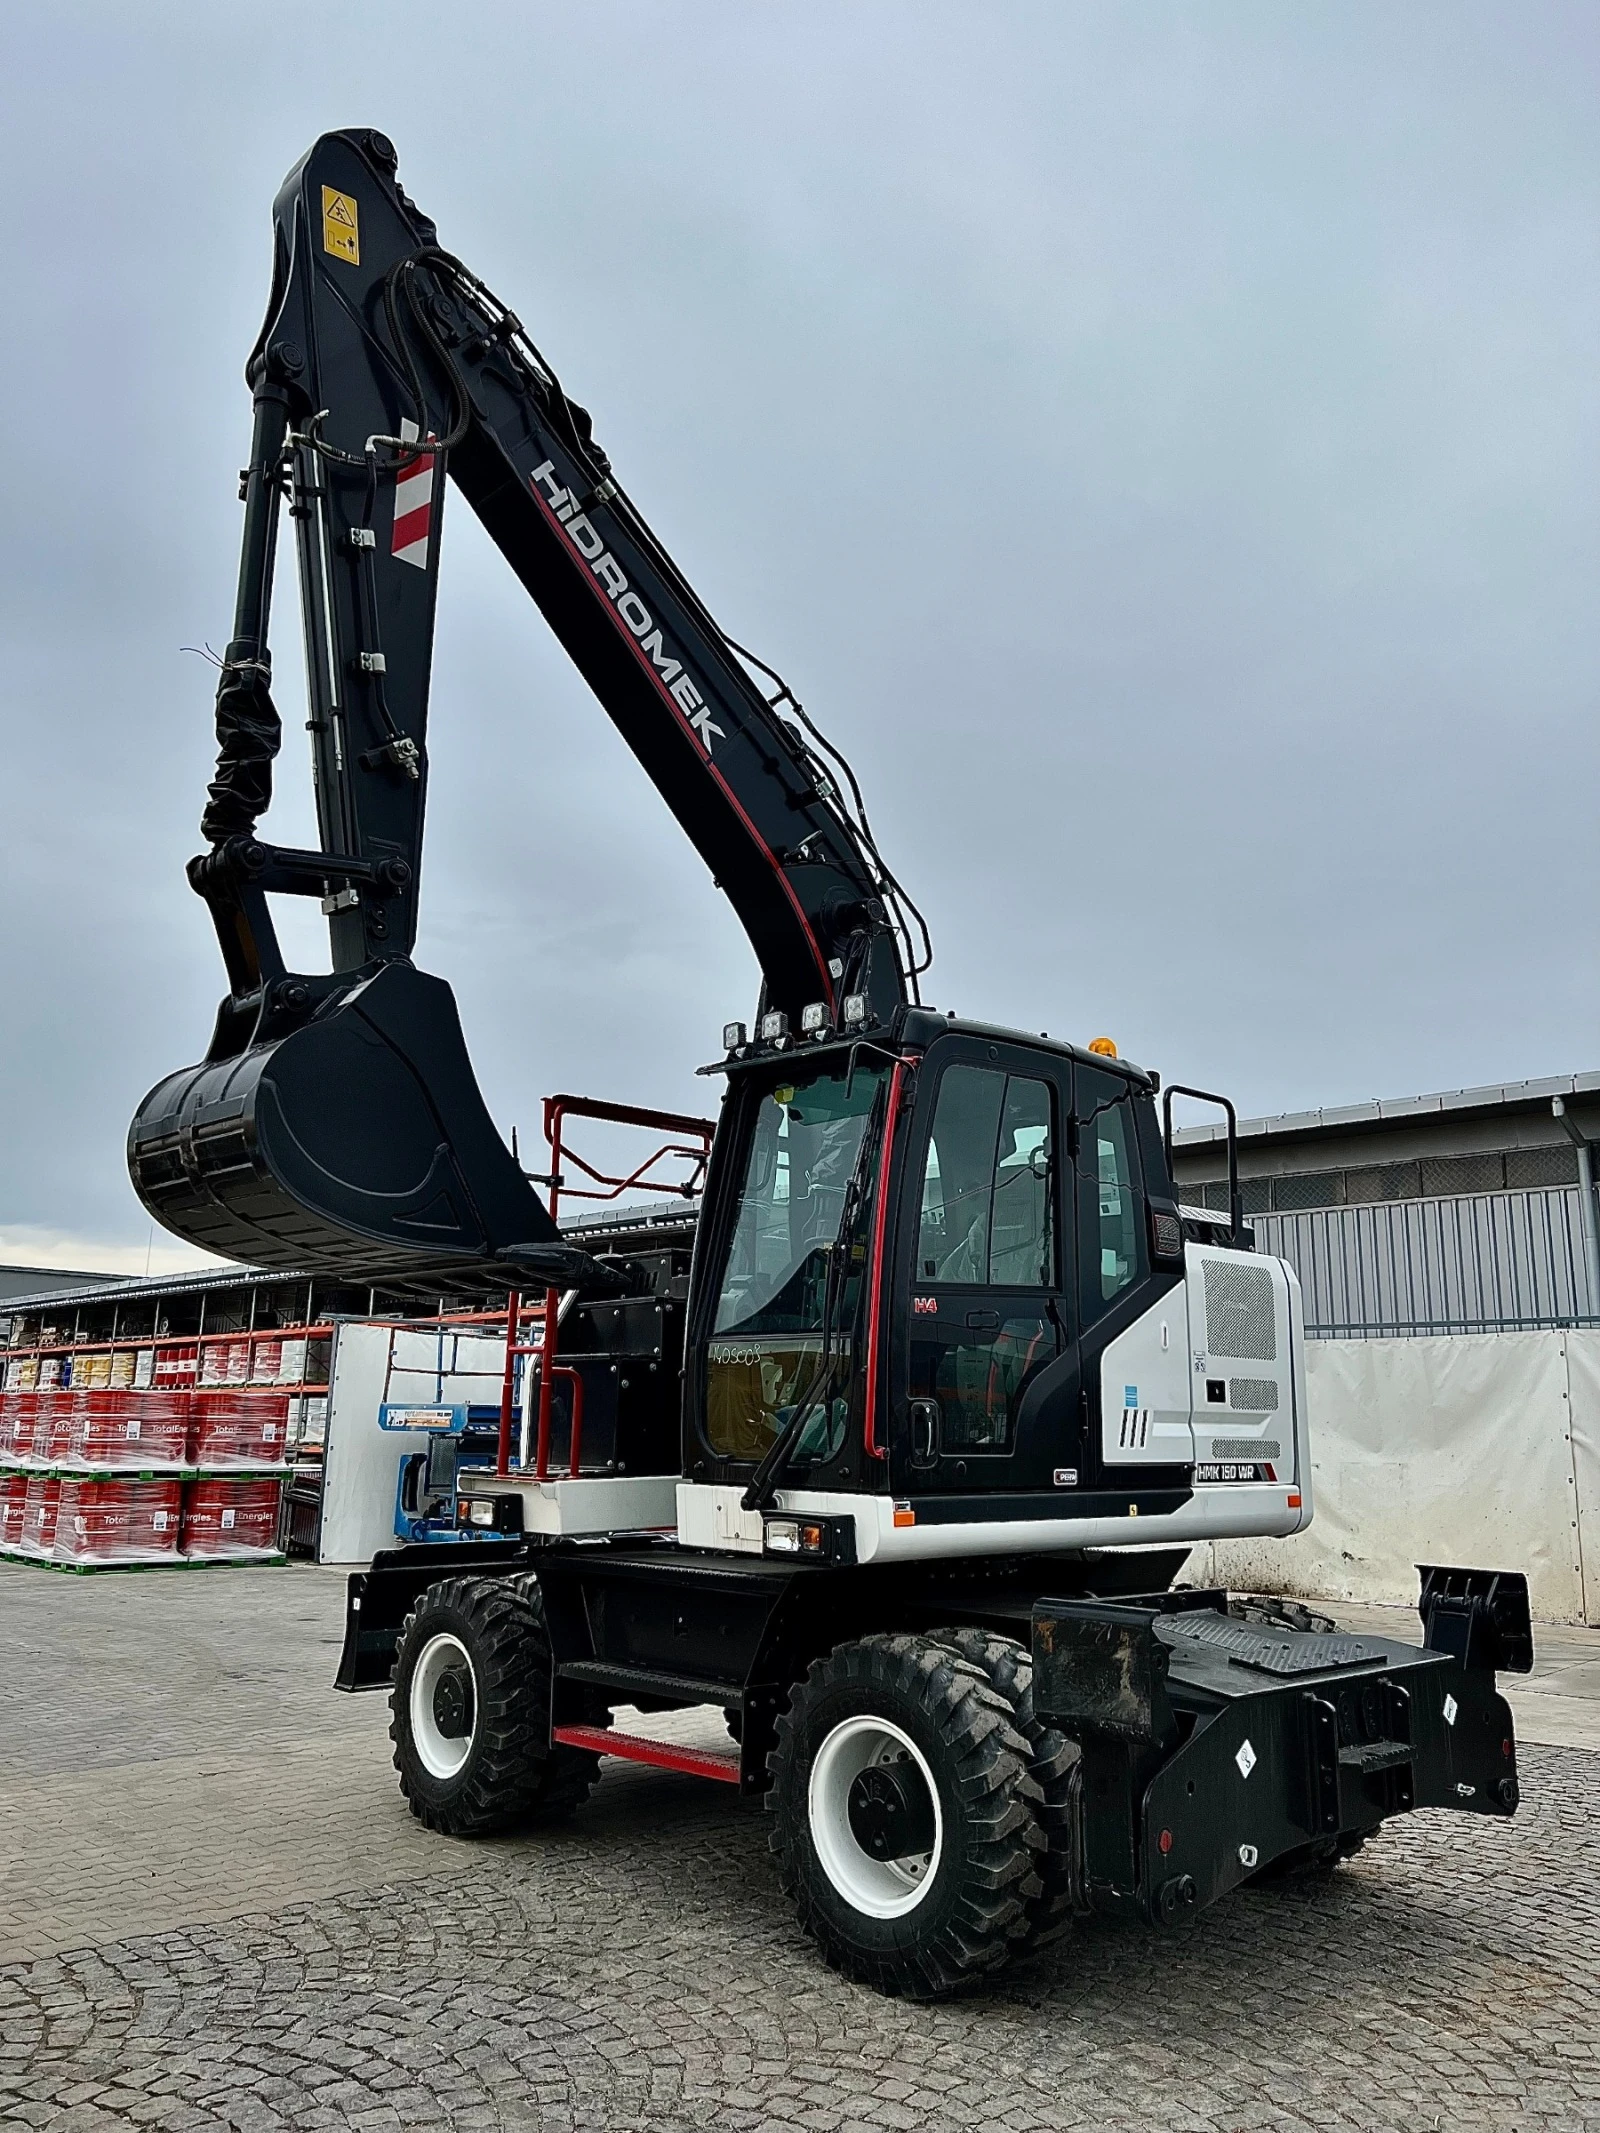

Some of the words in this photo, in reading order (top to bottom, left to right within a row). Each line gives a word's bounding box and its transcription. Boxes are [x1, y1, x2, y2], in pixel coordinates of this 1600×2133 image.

[914, 1297, 938, 1314] H4
[1198, 1465, 1220, 1480] HMK
[1221, 1465, 1237, 1480] 150
[1238, 1464, 1255, 1479] WR
